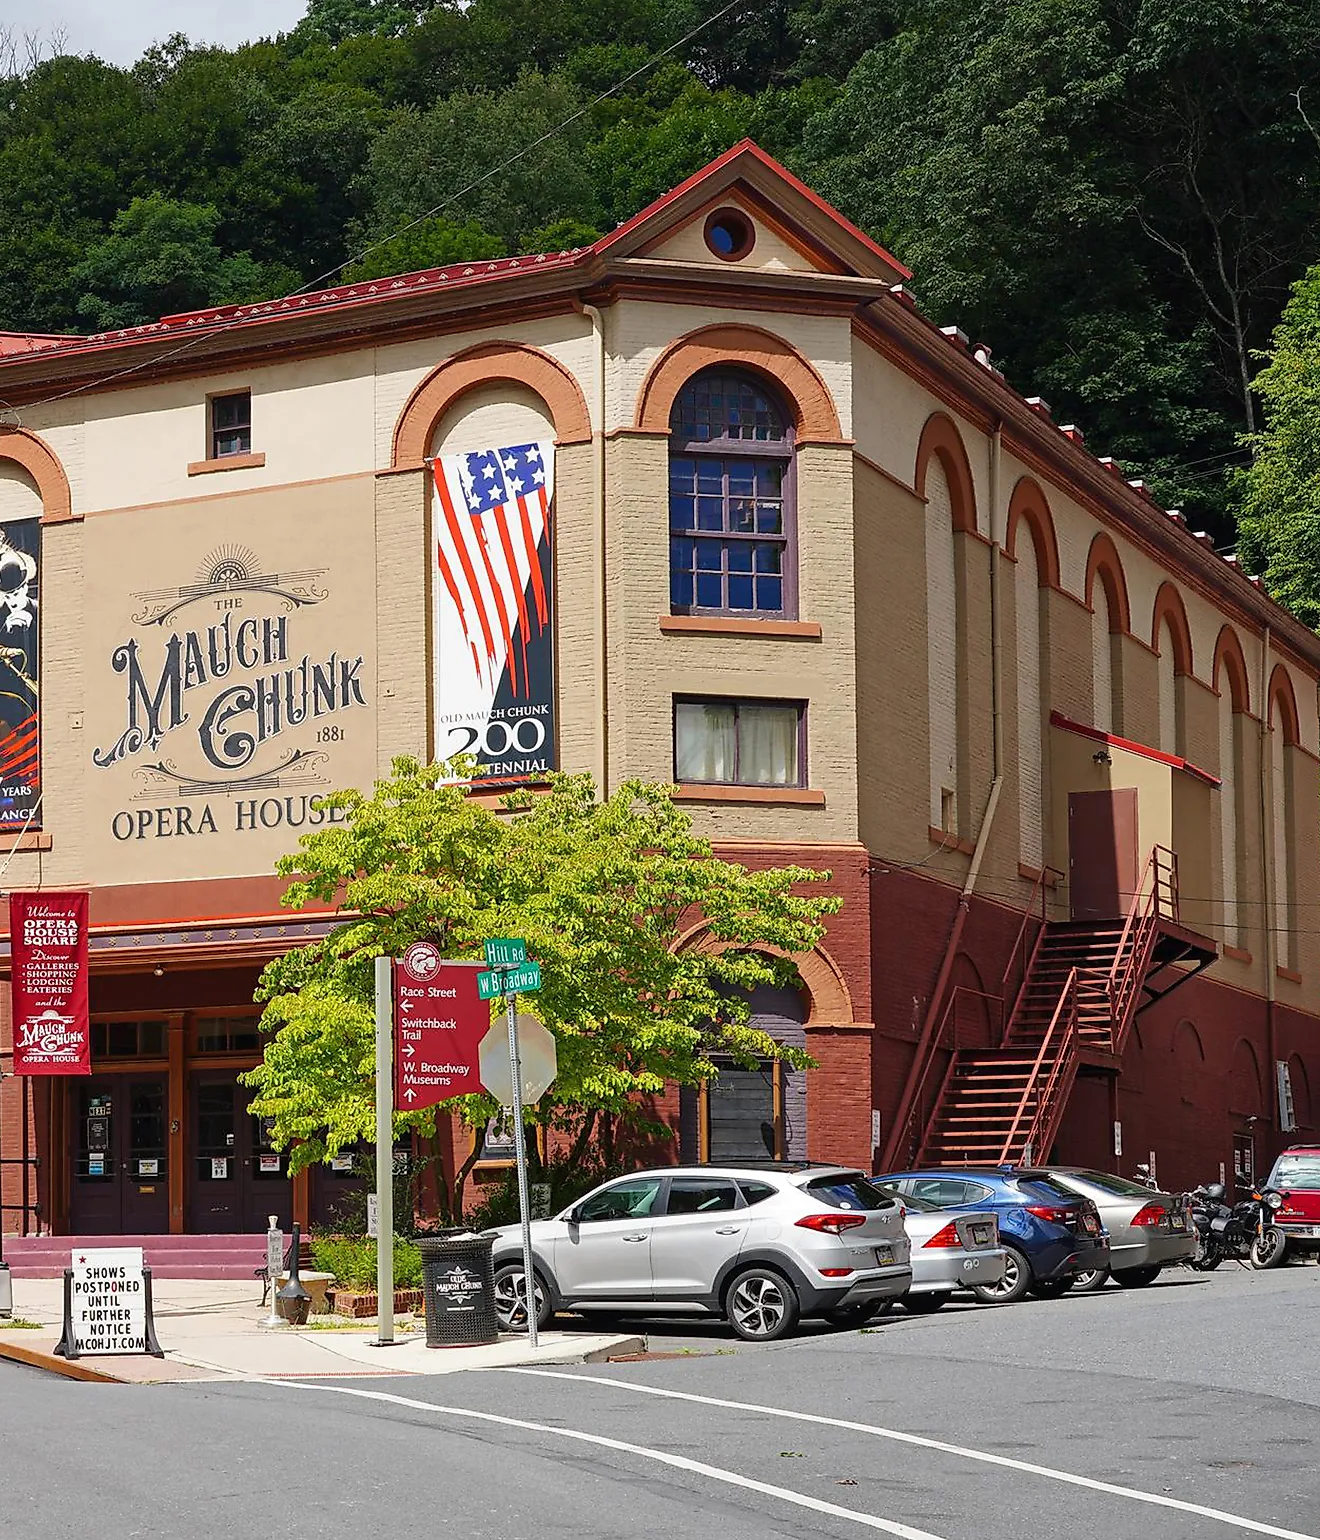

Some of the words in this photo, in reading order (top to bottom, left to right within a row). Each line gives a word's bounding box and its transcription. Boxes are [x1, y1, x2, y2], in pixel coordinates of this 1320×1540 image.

[214, 597, 243, 611] THE
[93, 612, 288, 768] MAUCH
[198, 651, 368, 770] CHUNK
[441, 713, 463, 723] OLD
[465, 709, 505, 721] MAUCH
[507, 704, 549, 717] CHUNK
[316, 726, 345, 743] 1881
[445, 718, 545, 764] 200
[2, 785, 32, 797] YEARS
[112, 804, 218, 840] OPERA
[235, 794, 346, 830] HOUSE
[27, 906, 65, 917] Welcome
[24, 919, 78, 928] OPERA
[24, 928, 78, 937] HOUSE
[23, 937, 78, 946] SQUARE
[31, 949, 69, 960] Discover
[487, 944, 509, 963] Hill
[512, 949, 524, 961] Rd
[481, 978, 489, 993] W
[491, 971, 538, 992] Broadway
[400, 986, 424, 997] Race
[427, 986, 457, 998] Street
[35, 996, 53, 1006] and
[53, 996, 66, 1006] the
[401, 1018, 457, 1029] Switchback
[16, 1022, 65, 1047] MAUCH
[402, 1030, 422, 1040] Trail
[40, 1031, 84, 1052] CHUNK
[403, 1062, 417, 1072] W.
[420, 1063, 470, 1076] Broadway
[403, 1075, 451, 1086] Museums
[86, 1267, 125, 1279] SHOWS
[75, 1281, 139, 1293] POSTPONED
[88, 1296, 120, 1307] UNTIL
[82, 1309, 131, 1321] FURTHER
[90, 1323, 131, 1335] NOTICE
[75, 1337, 144, 1349] MCOHJT.COM
